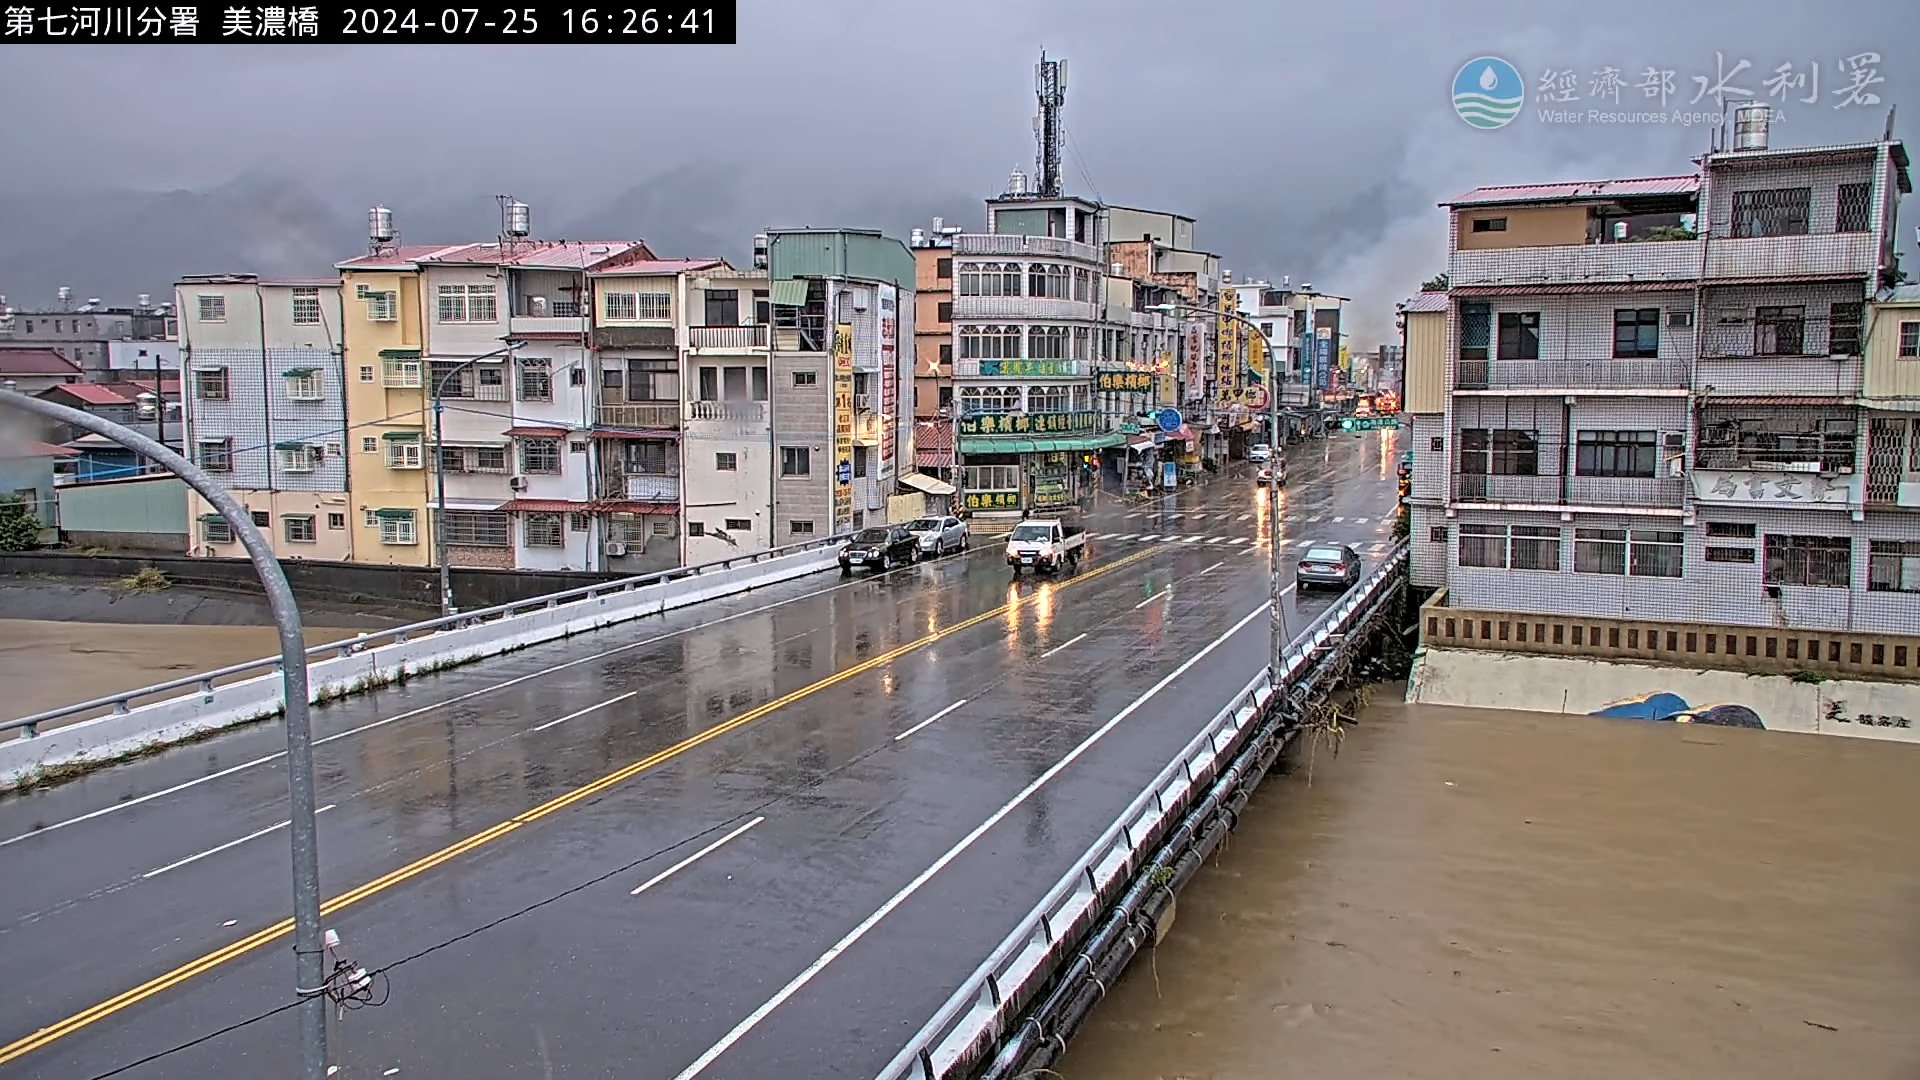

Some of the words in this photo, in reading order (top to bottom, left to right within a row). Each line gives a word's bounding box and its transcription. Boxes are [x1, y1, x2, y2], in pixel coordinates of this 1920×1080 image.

[1099, 374, 1151, 390] 伯樂檳榔
[966, 493, 1017, 508] 伯樂檳榔
